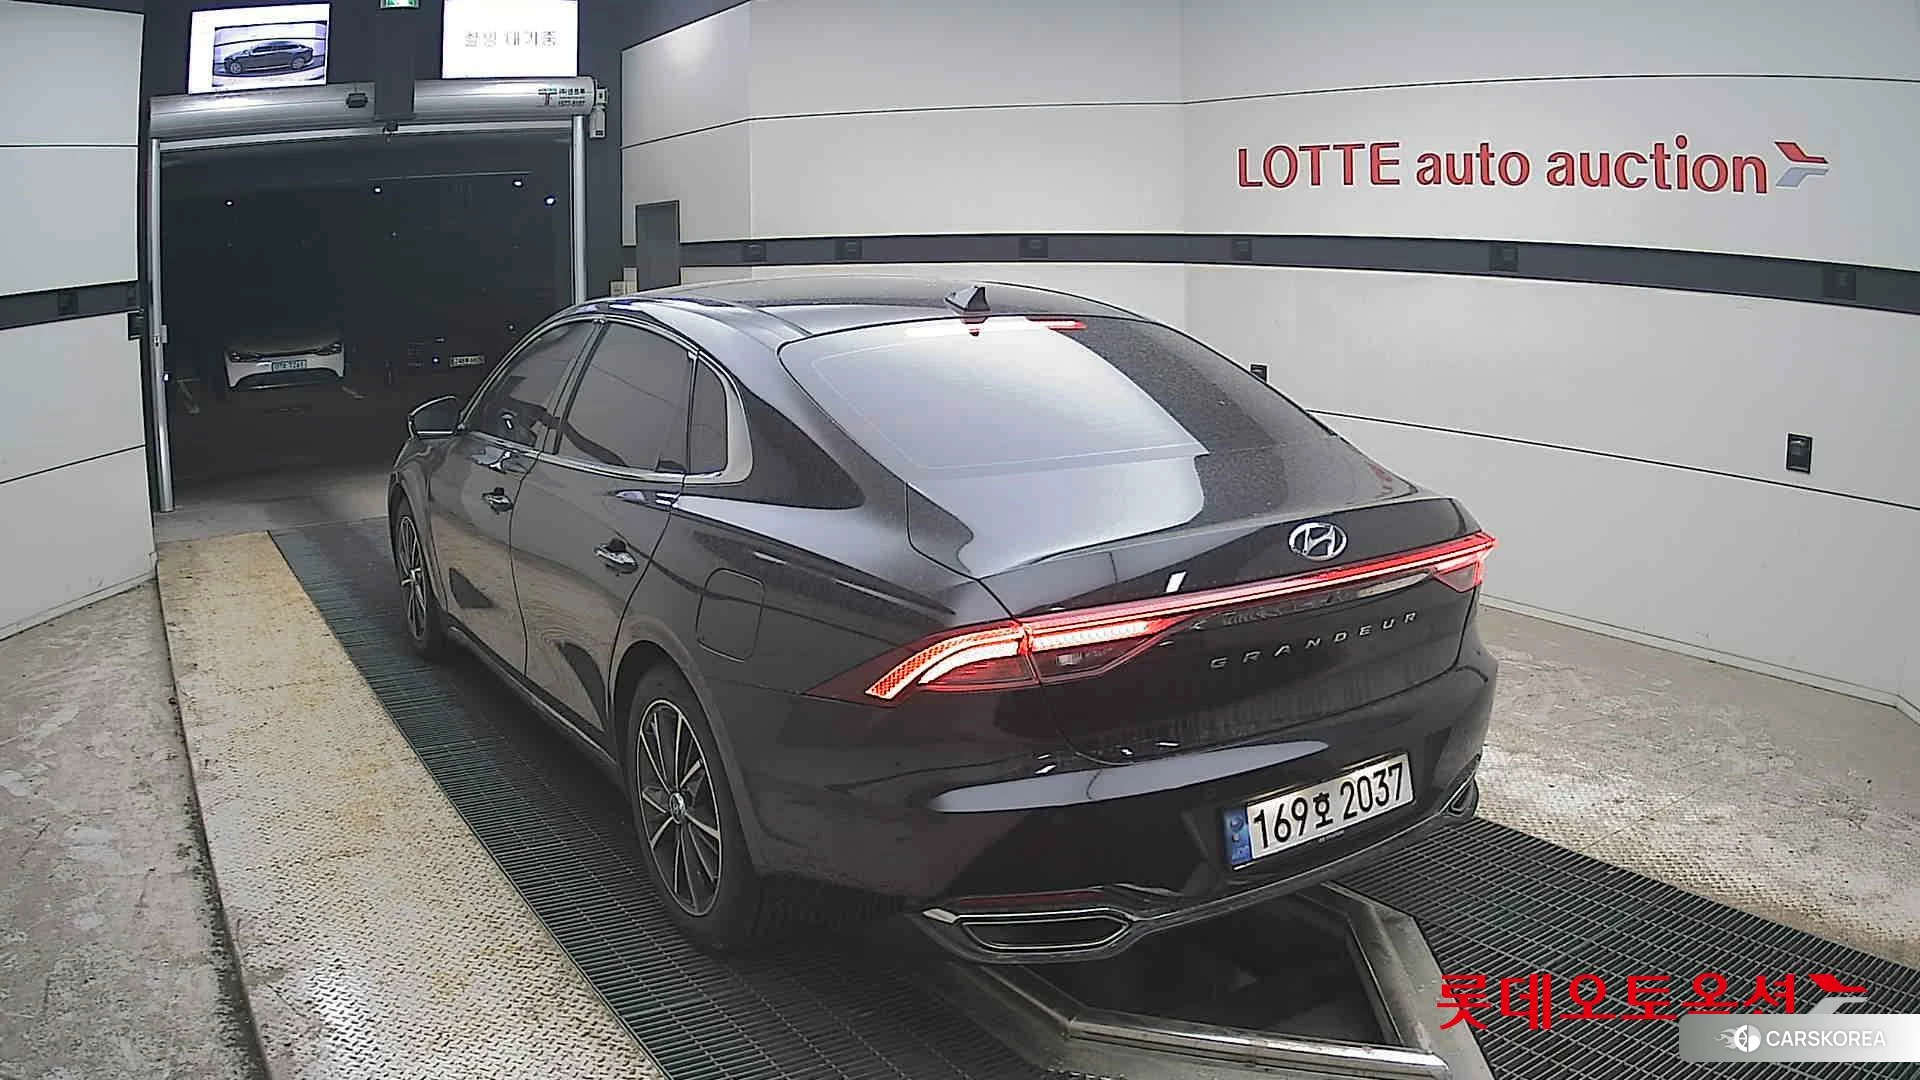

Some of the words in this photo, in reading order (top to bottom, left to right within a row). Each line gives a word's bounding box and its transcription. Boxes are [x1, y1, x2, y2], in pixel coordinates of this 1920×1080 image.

[1237, 141, 1401, 189] LOTTE
[1416, 142, 1531, 187] auto
[1546, 134, 1768, 194] auction
[1210, 611, 1416, 669] GRANDEUR
[1253, 791, 1334, 849] 169호
[1340, 761, 1403, 820] 2037
